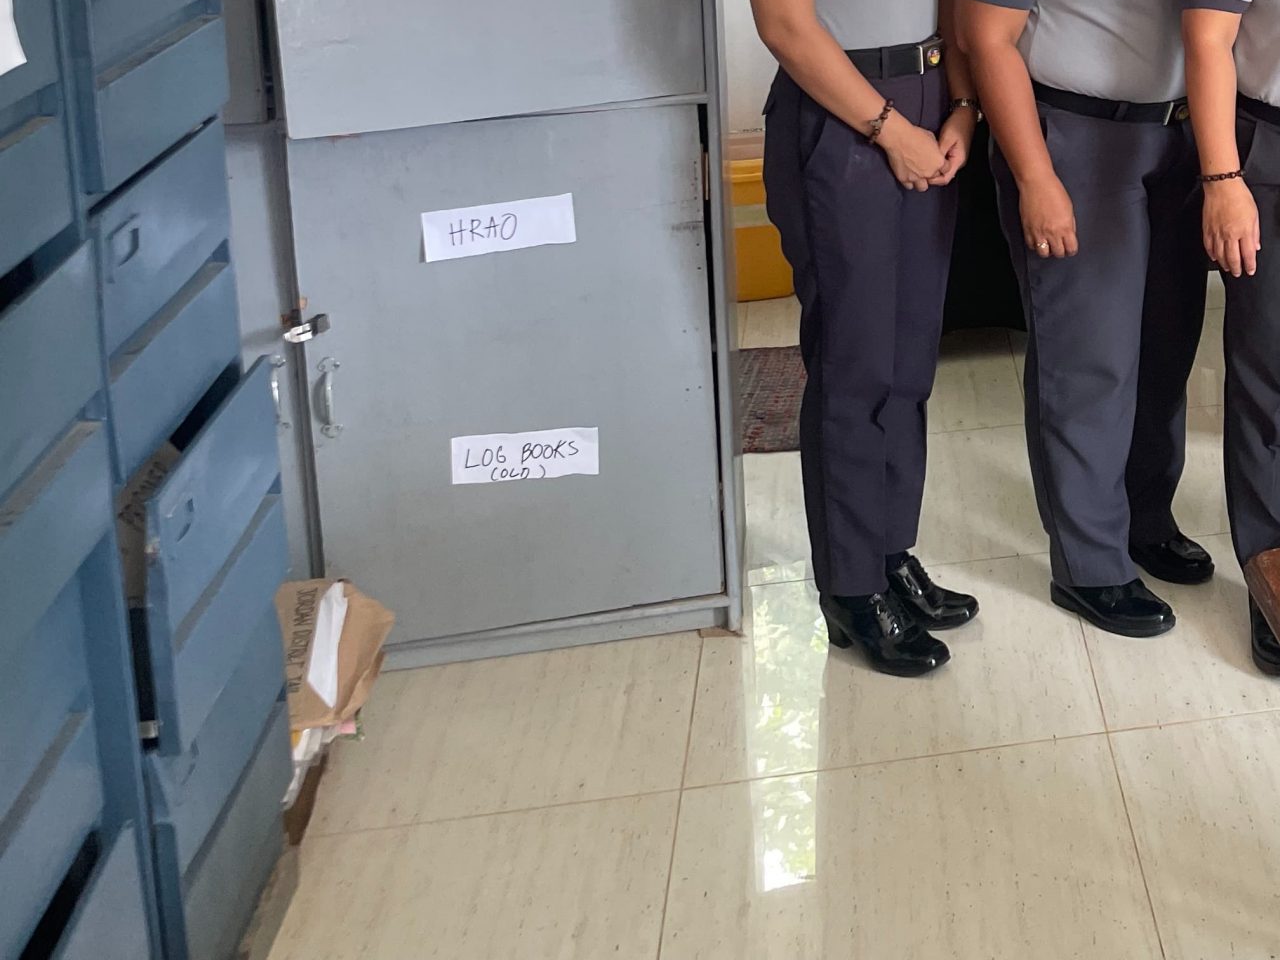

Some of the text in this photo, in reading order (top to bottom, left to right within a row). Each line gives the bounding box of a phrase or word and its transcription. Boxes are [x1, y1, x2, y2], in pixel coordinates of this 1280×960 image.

[448, 212, 518, 246] HRAO
[464, 440, 580, 469] LOG BOOKS
